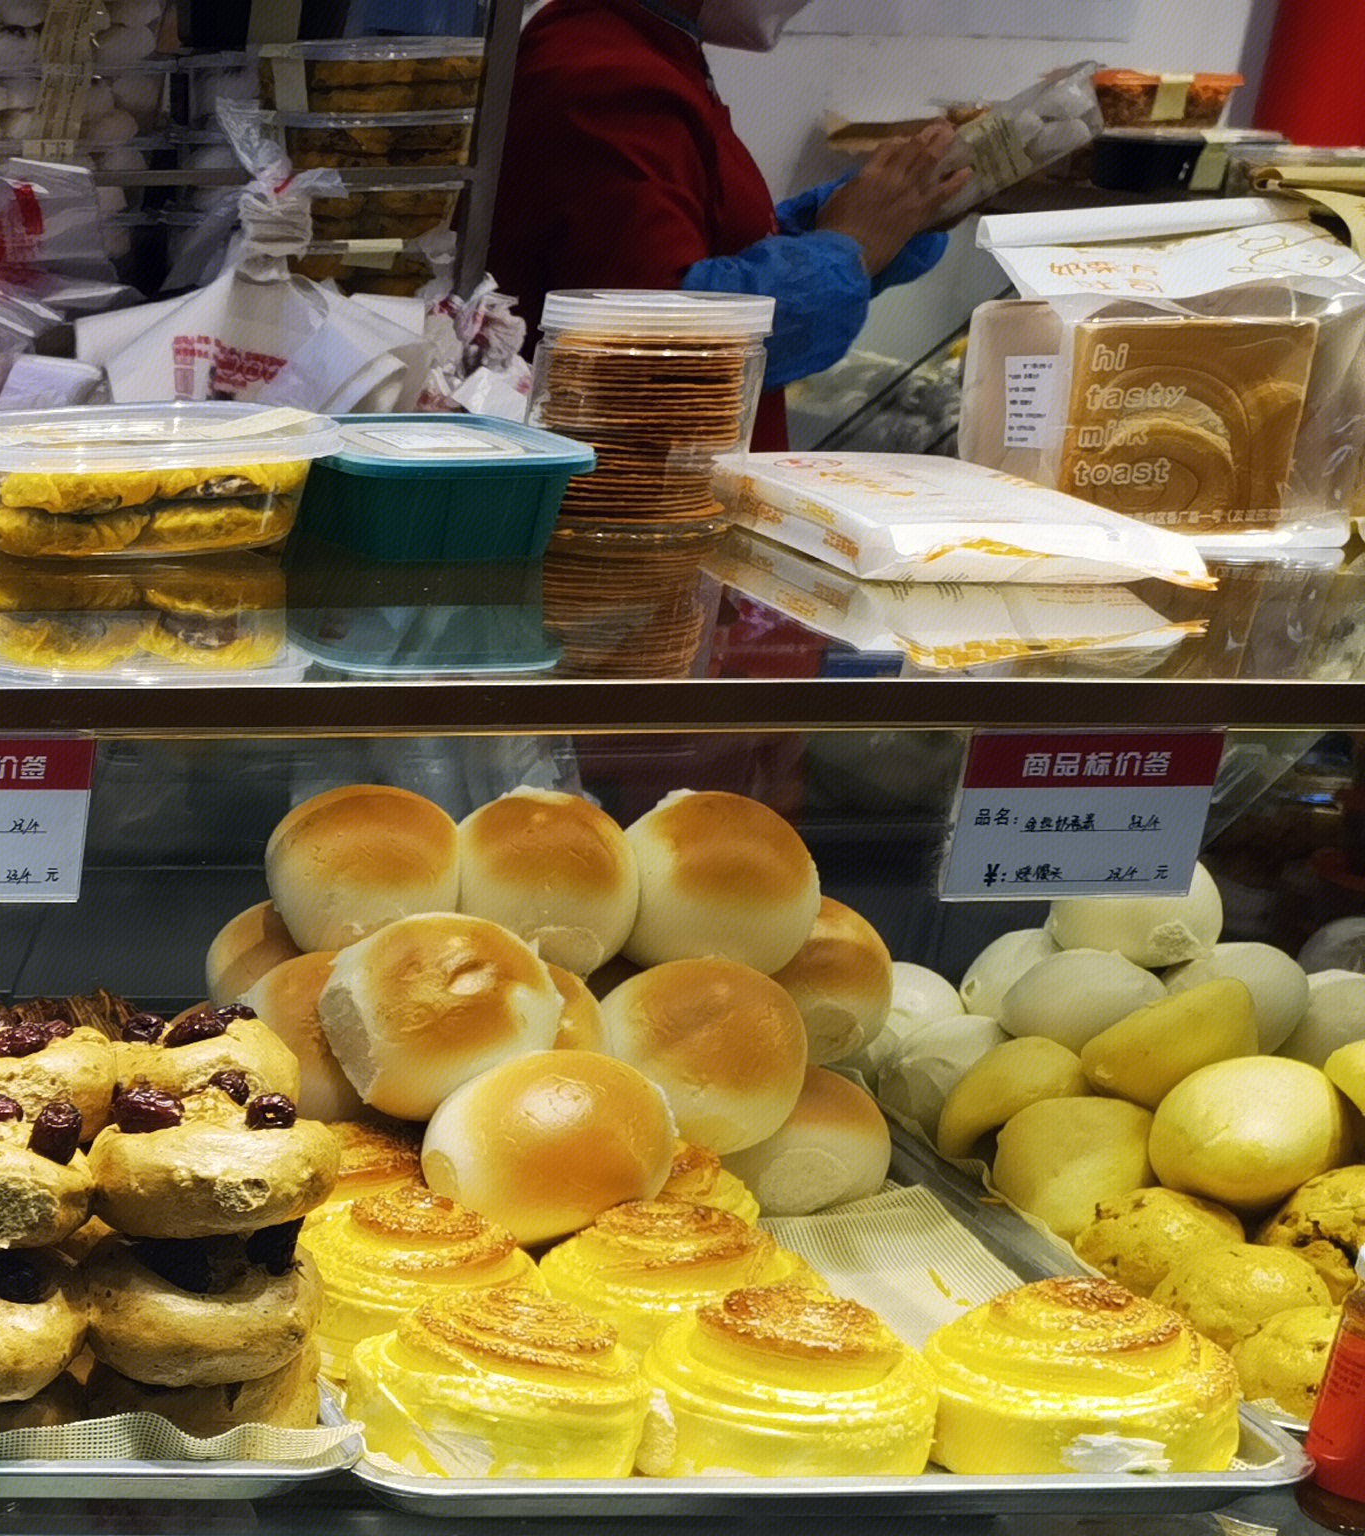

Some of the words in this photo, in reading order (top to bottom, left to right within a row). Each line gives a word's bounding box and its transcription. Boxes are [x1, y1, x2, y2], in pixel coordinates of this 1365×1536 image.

[1091, 343, 1130, 372] hi
[1086, 382, 1187, 412] tasty
[1078, 422, 1150, 449] milk
[1072, 457, 1171, 486] toast
[1022, 750, 1173, 777] 商品标价签
[44, 868, 59, 883] 元
[1153, 865, 1169, 880] 元
